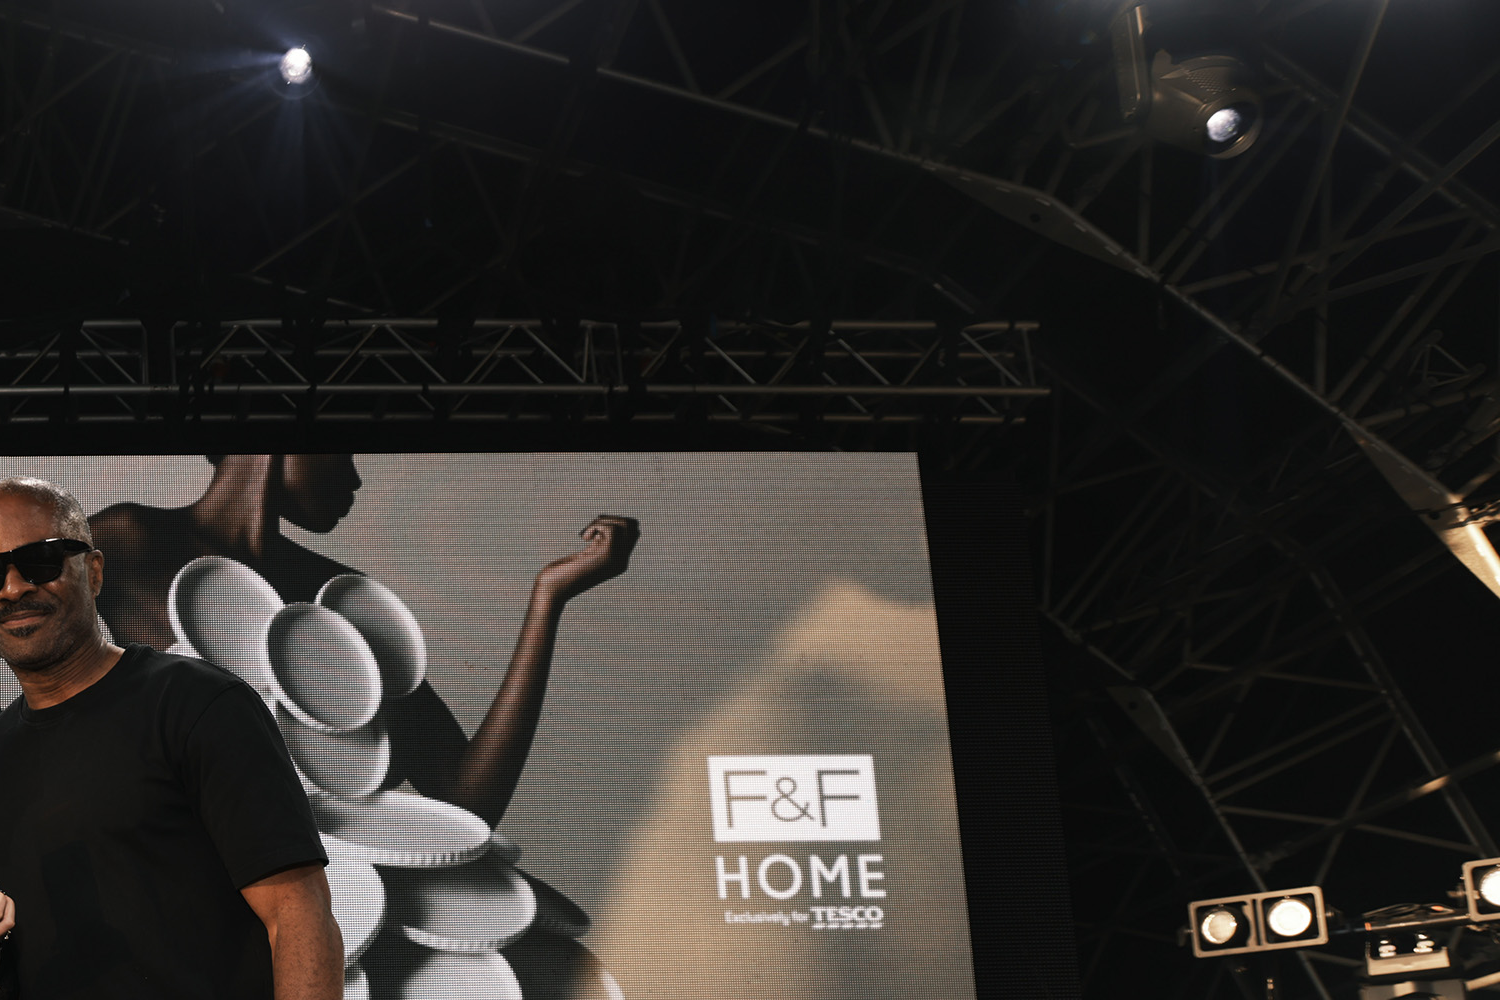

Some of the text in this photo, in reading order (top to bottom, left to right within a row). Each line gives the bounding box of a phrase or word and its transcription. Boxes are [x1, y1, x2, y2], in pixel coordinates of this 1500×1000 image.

[723, 769, 860, 828] F&F
[714, 853, 888, 900] HOME
[810, 905, 885, 922] TESCO
